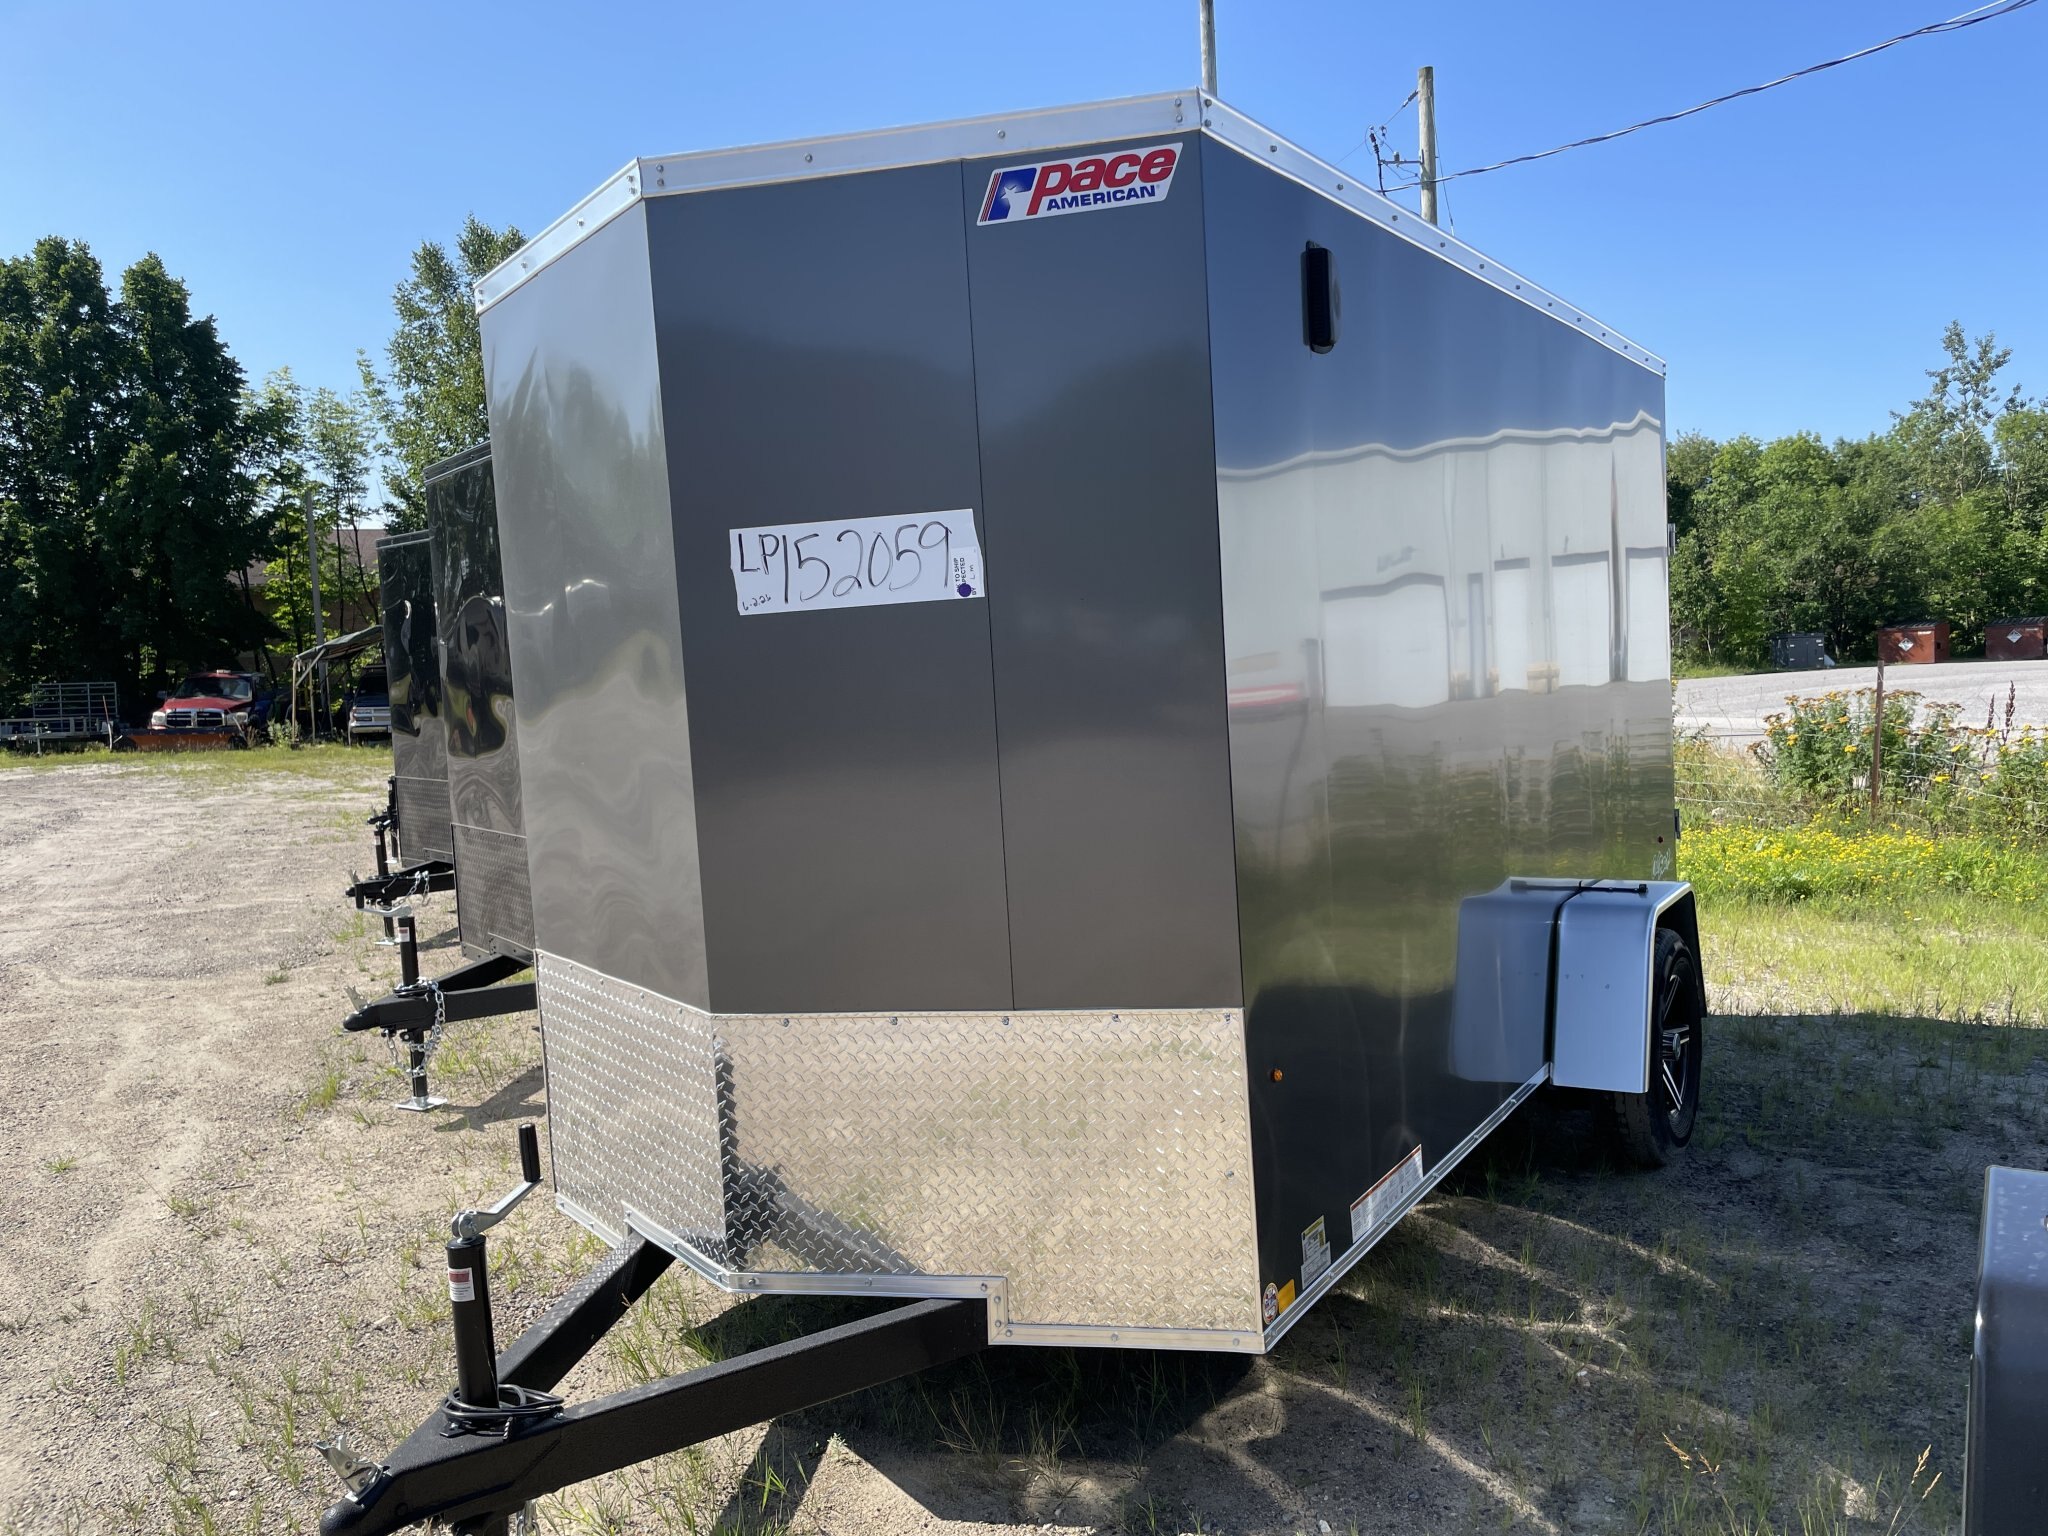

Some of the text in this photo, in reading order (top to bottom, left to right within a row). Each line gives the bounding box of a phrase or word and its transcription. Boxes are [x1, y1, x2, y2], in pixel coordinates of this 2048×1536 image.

[1026, 148, 1177, 216] pace
[1046, 184, 1156, 212] AMERICAN
[738, 520, 952, 604] LP152059
[955, 574, 960, 582] TO
